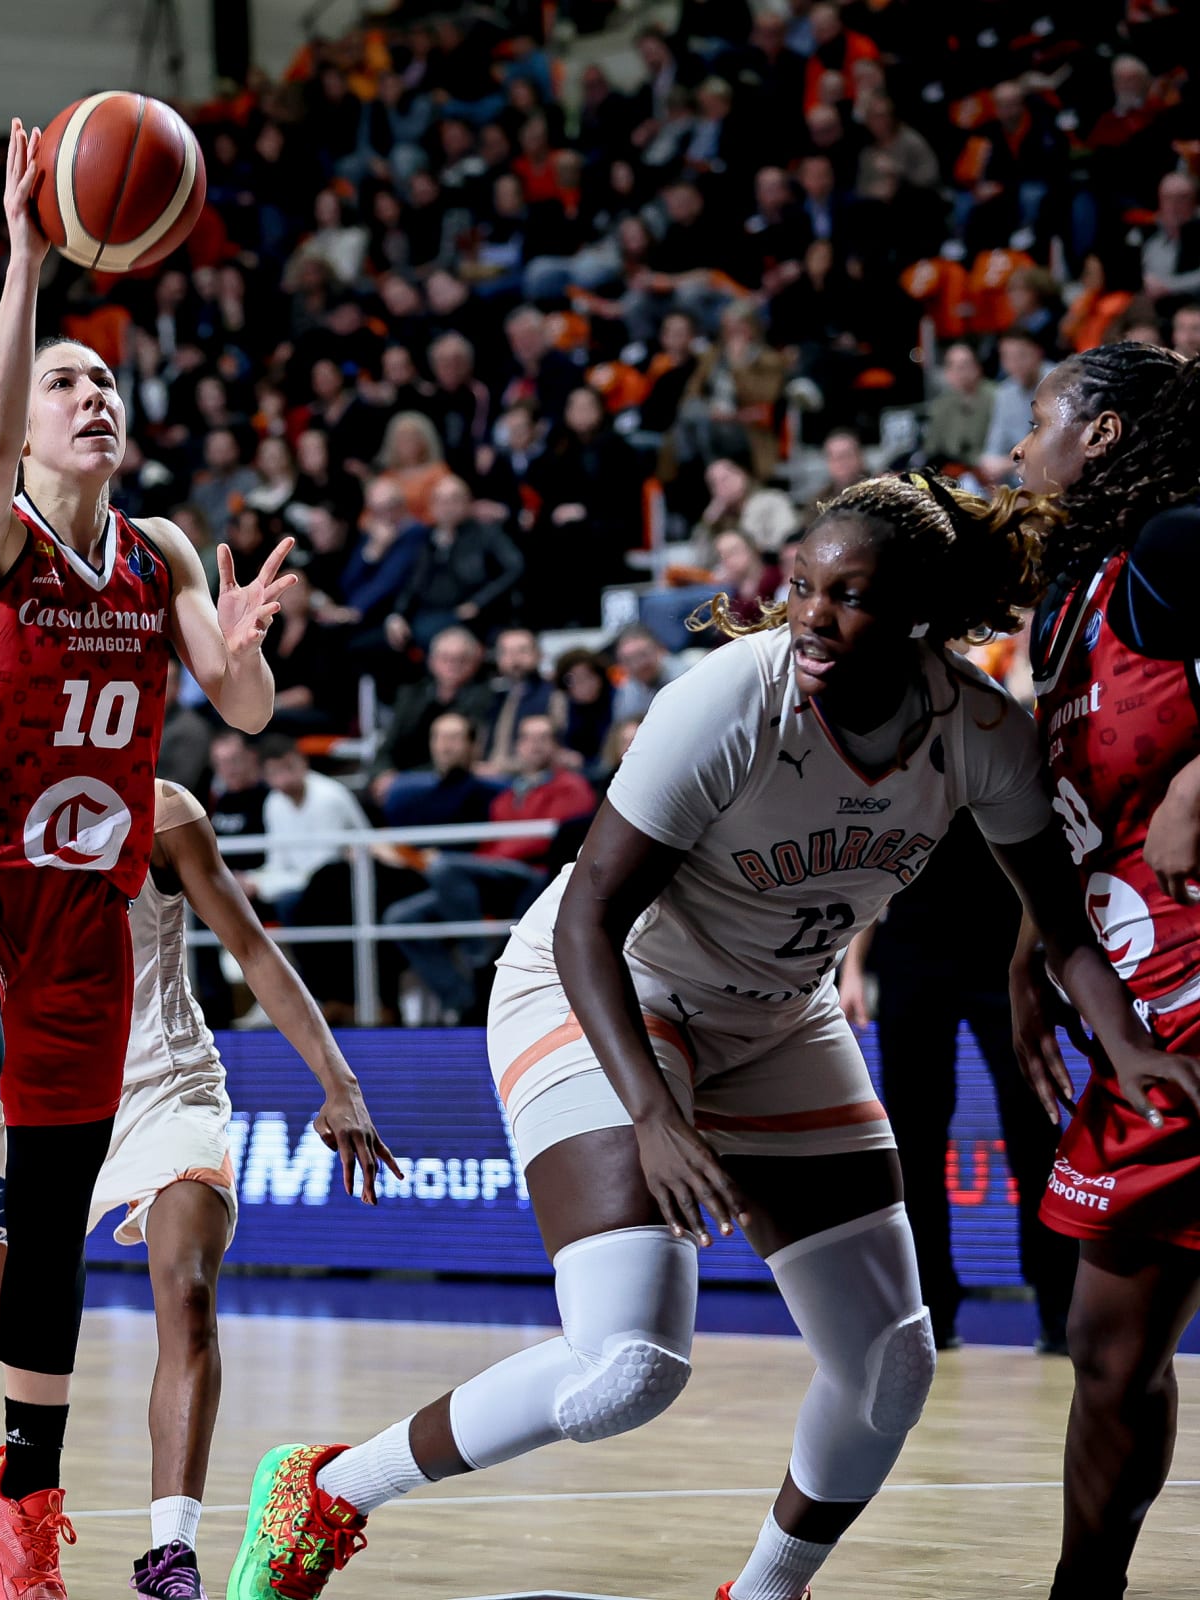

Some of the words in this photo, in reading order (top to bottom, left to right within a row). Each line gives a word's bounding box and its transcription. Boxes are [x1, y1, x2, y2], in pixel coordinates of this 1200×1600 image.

[67, 636, 142, 653] ZARAGOZA
[53, 679, 140, 749] 10
[774, 903, 856, 959] 22
